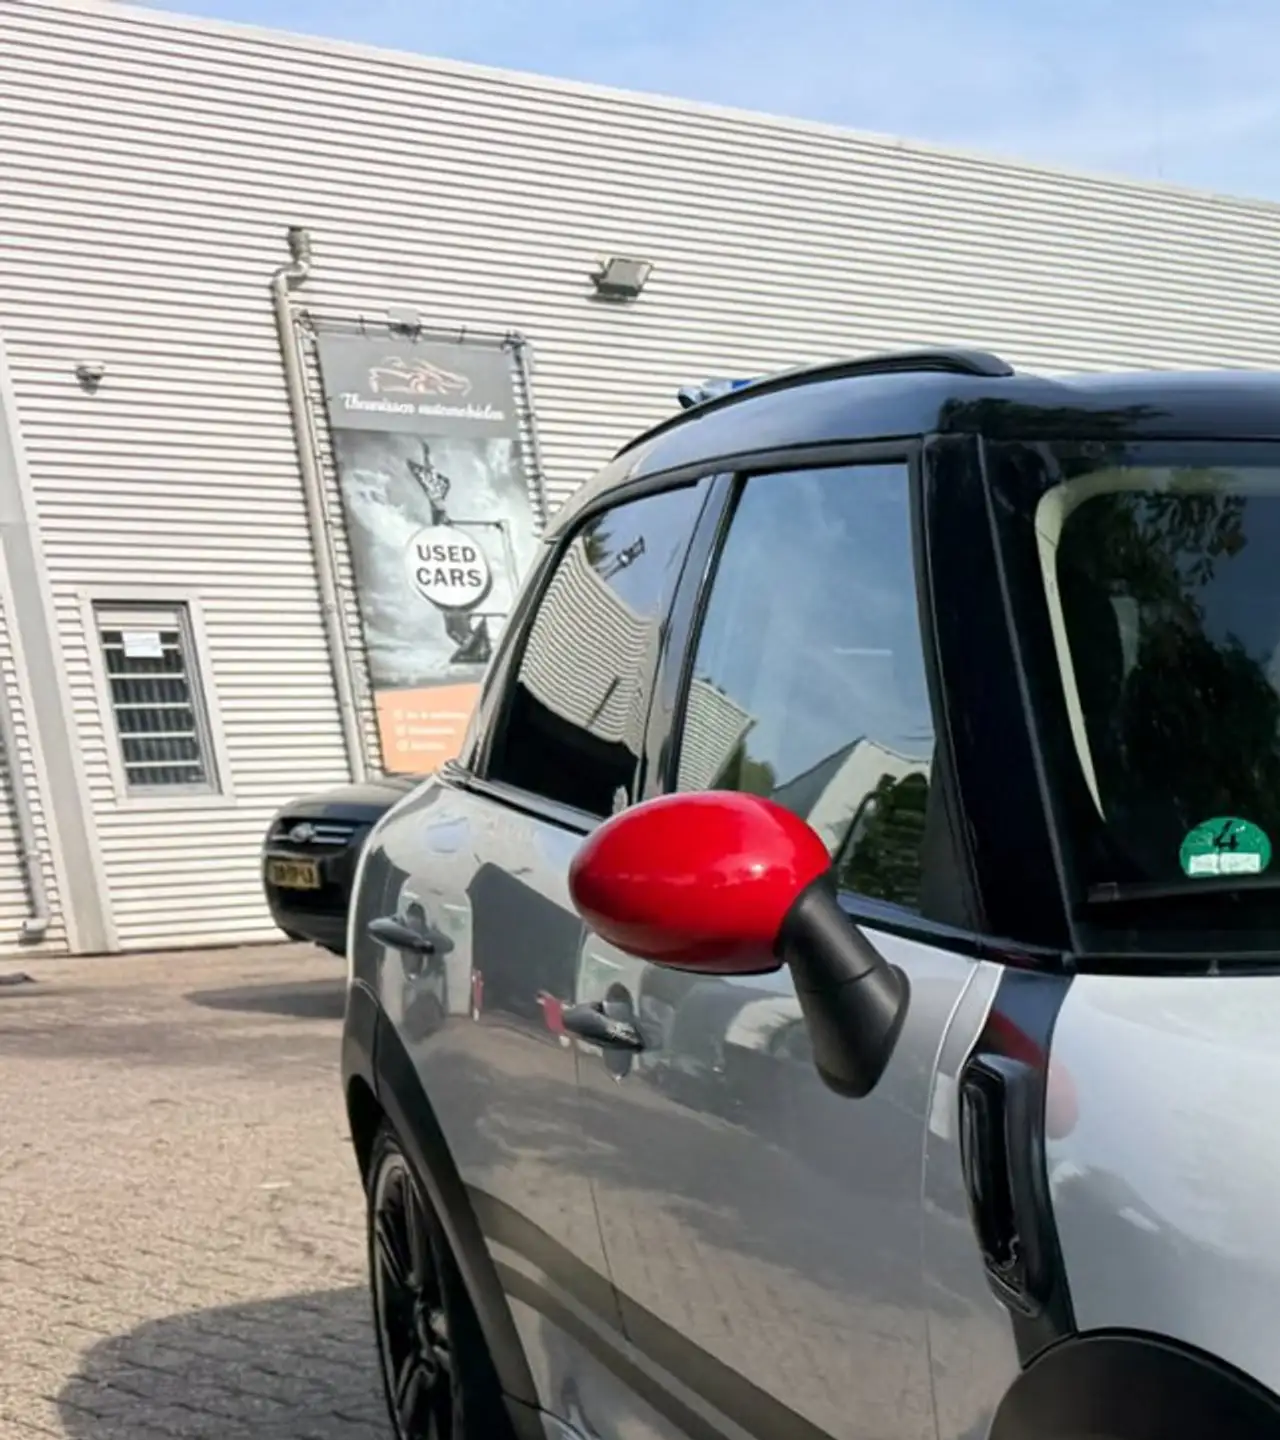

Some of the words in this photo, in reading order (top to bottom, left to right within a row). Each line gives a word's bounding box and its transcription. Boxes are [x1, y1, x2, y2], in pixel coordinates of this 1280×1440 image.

[416, 543, 477, 563] USED
[415, 566, 483, 588] CARS
[1214, 820, 1240, 851] 4
